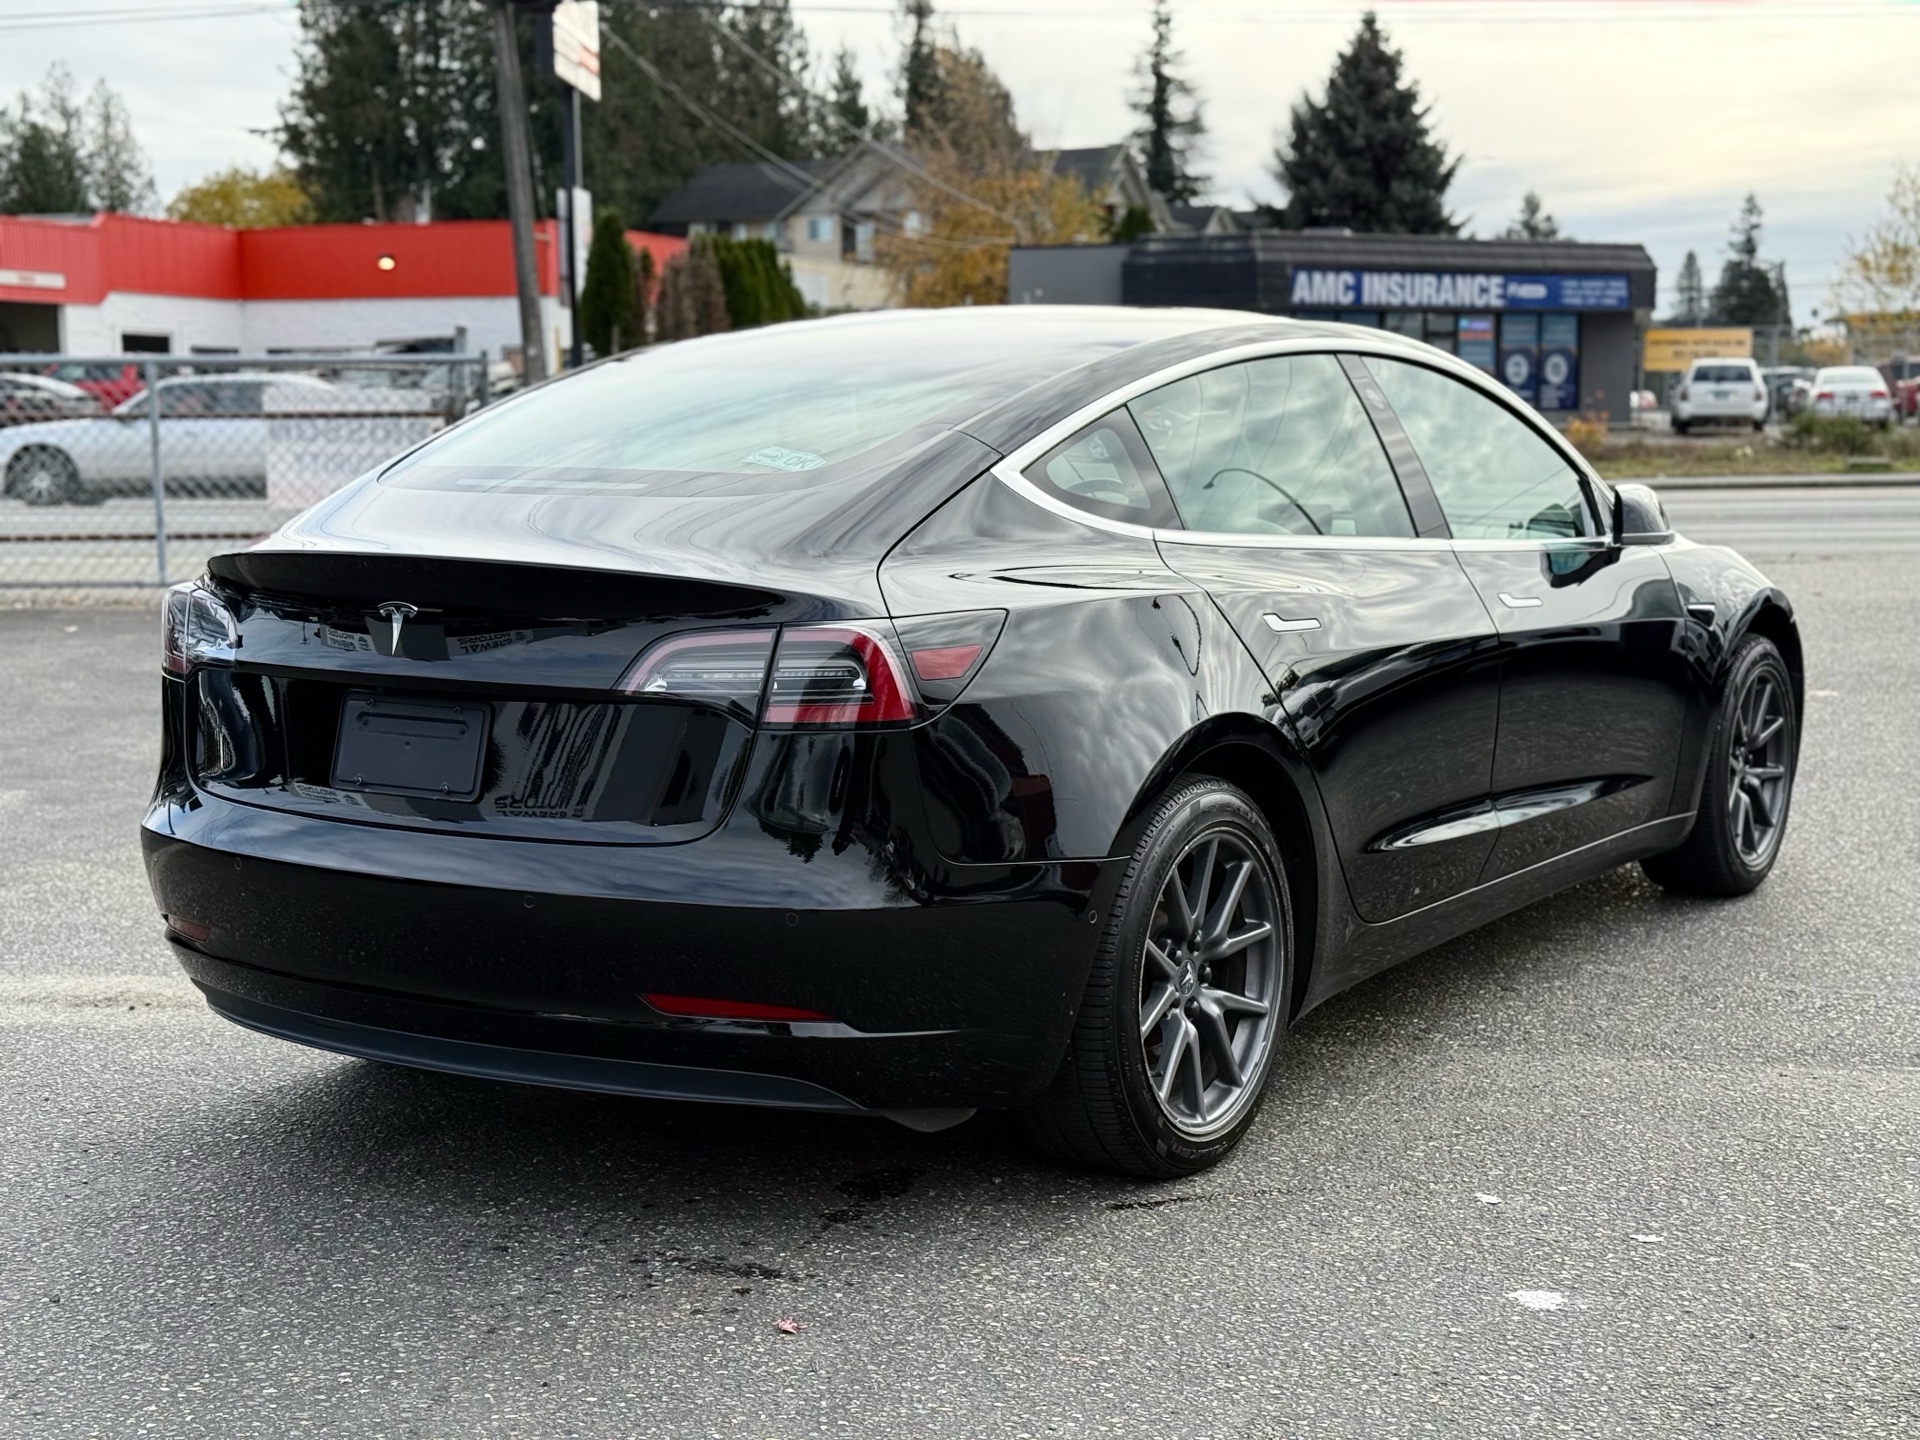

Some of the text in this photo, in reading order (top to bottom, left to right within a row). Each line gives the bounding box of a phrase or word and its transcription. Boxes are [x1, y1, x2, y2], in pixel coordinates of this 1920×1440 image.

[1291, 270, 1356, 305] AMC
[1361, 272, 1506, 307] INSURANCE
[457, 632, 511, 645] MOTORS
[460, 638, 513, 655] GREWAL
